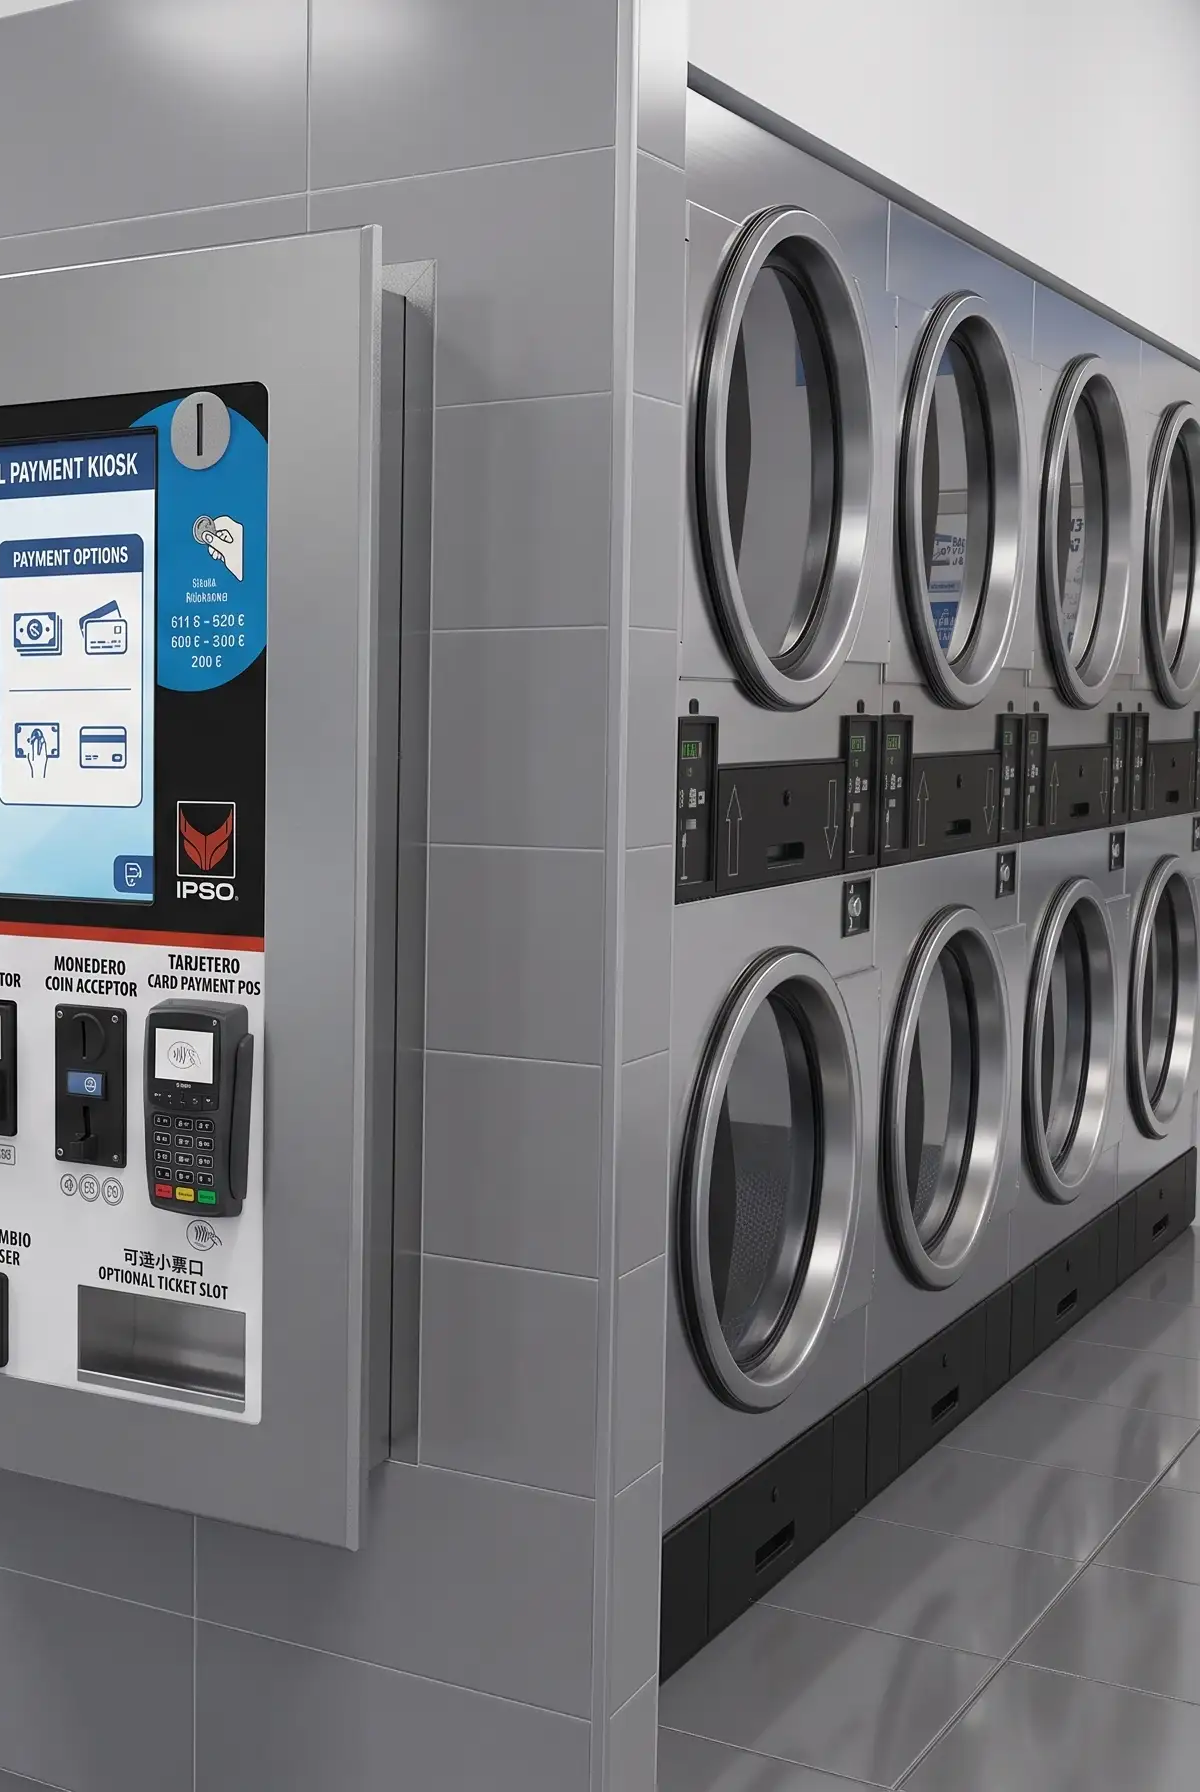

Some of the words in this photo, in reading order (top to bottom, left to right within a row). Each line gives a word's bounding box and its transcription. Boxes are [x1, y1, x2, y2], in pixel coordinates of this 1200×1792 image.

[10, 457, 84, 484] PAYMENT
[87, 452, 139, 478] KIOSK
[13, 549, 71, 568] PAYMENT
[73, 546, 129, 565] OPTIONS
[171, 615, 189, 628] 611
[171, 635, 191, 648] 600
[212, 634, 235, 648] 300
[191, 655, 212, 668] 200
[54, 955, 126, 976] MONEDERO
[168, 954, 240, 974] TARJETERO
[45, 975, 75, 993] COIN
[76, 978, 138, 997] ACCEPTOR
[148, 973, 178, 990] CARD
[180, 976, 235, 994] PAYMENT
[238, 980, 261, 996] POS
[98, 1266, 155, 1289] OPTIONAL
[157, 1275, 197, 1295] TICKET
[199, 1282, 229, 1300] SLOT
